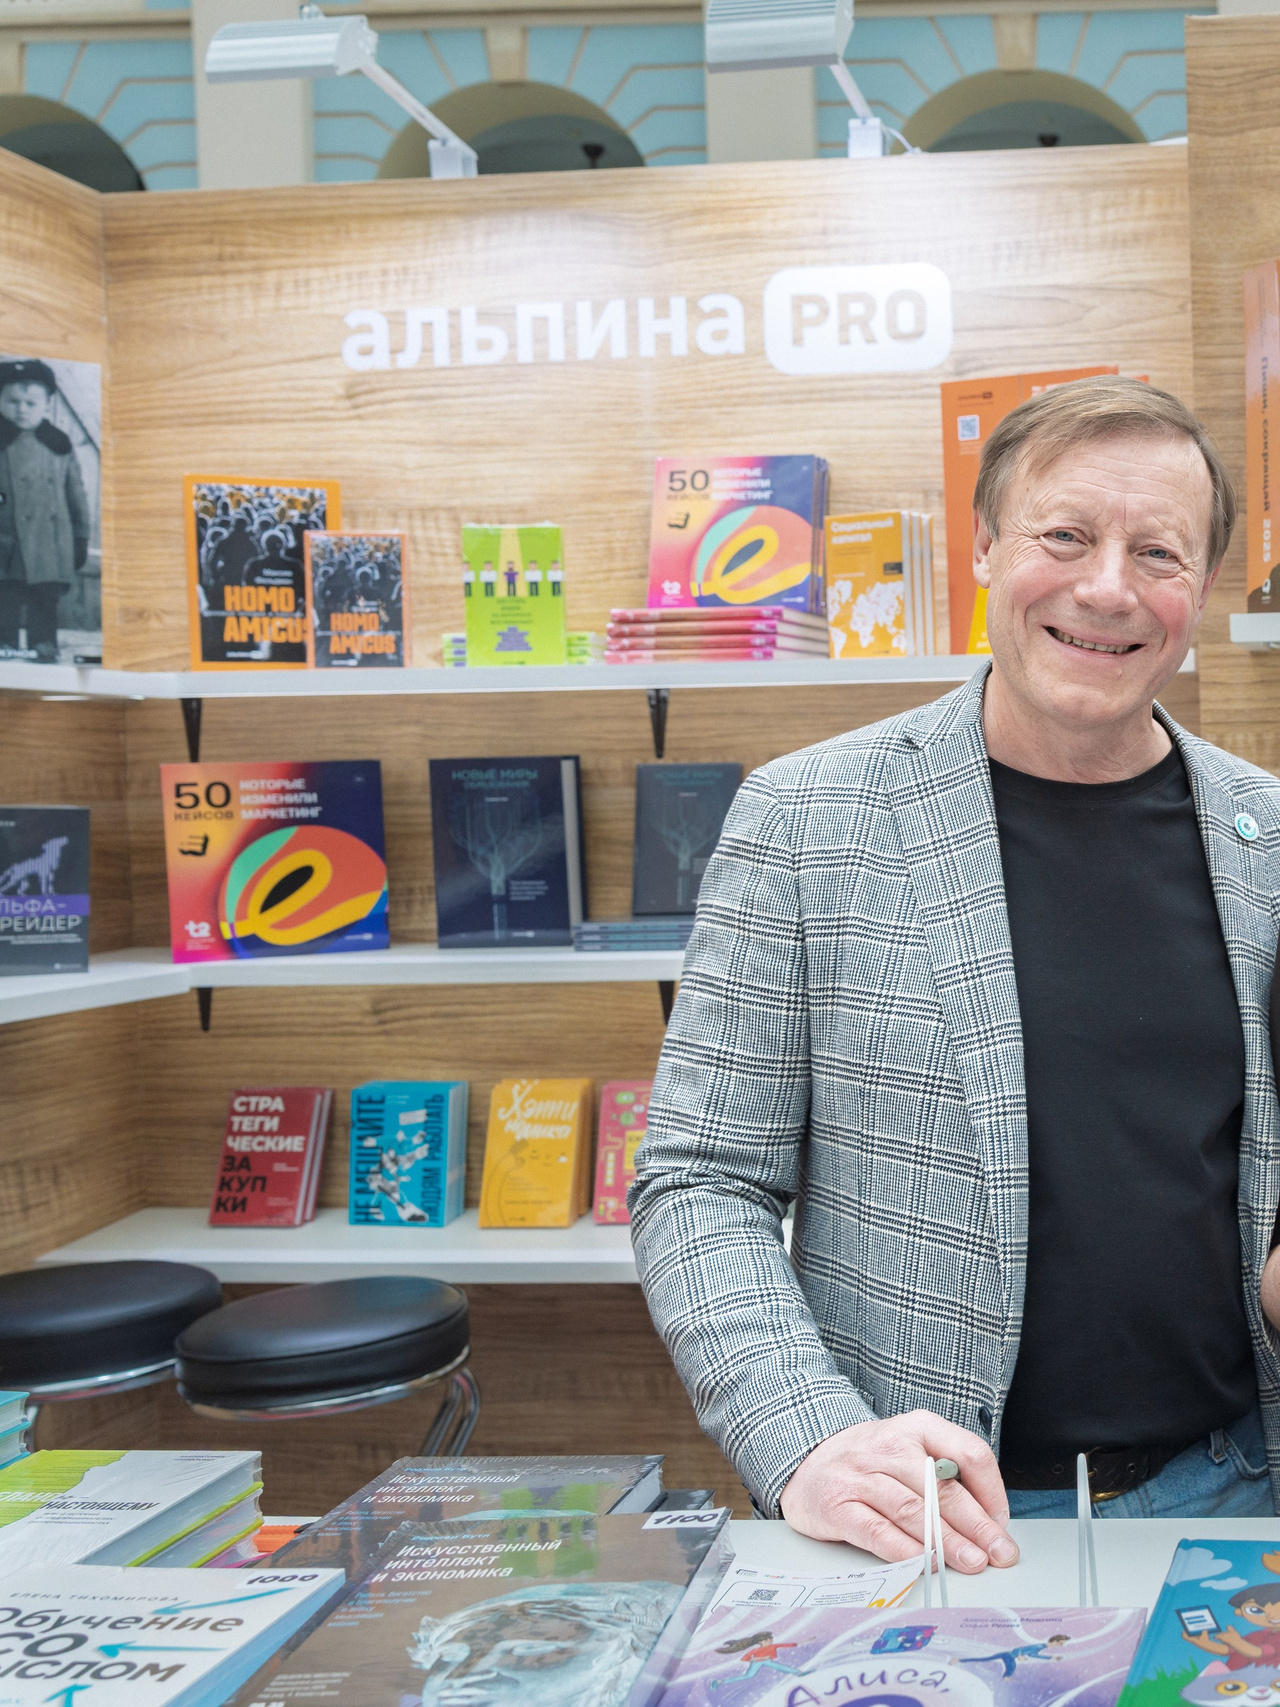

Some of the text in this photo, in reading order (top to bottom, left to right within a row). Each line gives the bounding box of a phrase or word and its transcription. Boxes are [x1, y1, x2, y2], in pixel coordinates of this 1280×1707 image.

[789, 289, 928, 347] PRO
[341, 293, 746, 371] альпина
[668, 470, 710, 492] 50
[1262, 518, 1271, 563] 2025
[224, 585, 295, 612] HOMO
[330, 613, 380, 632] HOMO
[329, 635, 396, 655] AMICUS
[239, 778, 306, 790] КОТОРЫЕ
[174, 781, 232, 810] 50
[241, 806, 323, 820] МАРКЕТИНГ
[233, 1096, 285, 1113] СТРА
[230, 1116, 280, 1133] ТЕГИ
[226, 1135, 306, 1153] ЧЕСКИЕ
[222, 1155, 252, 1173] ЗА
[218, 1175, 267, 1193] КУП
[215, 1196, 248, 1214] КИ
[354, 1200, 382, 1224] НЕ
[389, 1474, 521, 1486] Искусственный
[375, 1485, 468, 1494] интеллект
[40, 1501, 160, 1511] НАСТОЯЩЕМУ
[362, 1494, 475, 1504] и экономика
[653, 1513, 719, 1526] 1100
[411, 1533, 459, 1542] Роджер
[396, 1539, 563, 1558] Искусственный
[384, 1555, 501, 1570] интеллект
[247, 1574, 319, 1586] 1000
[371, 1567, 514, 1583] и экономика
[69, 1594, 179, 1602] ТИХОМИРОВА
[787, 1668, 951, 1707] Алиса,
